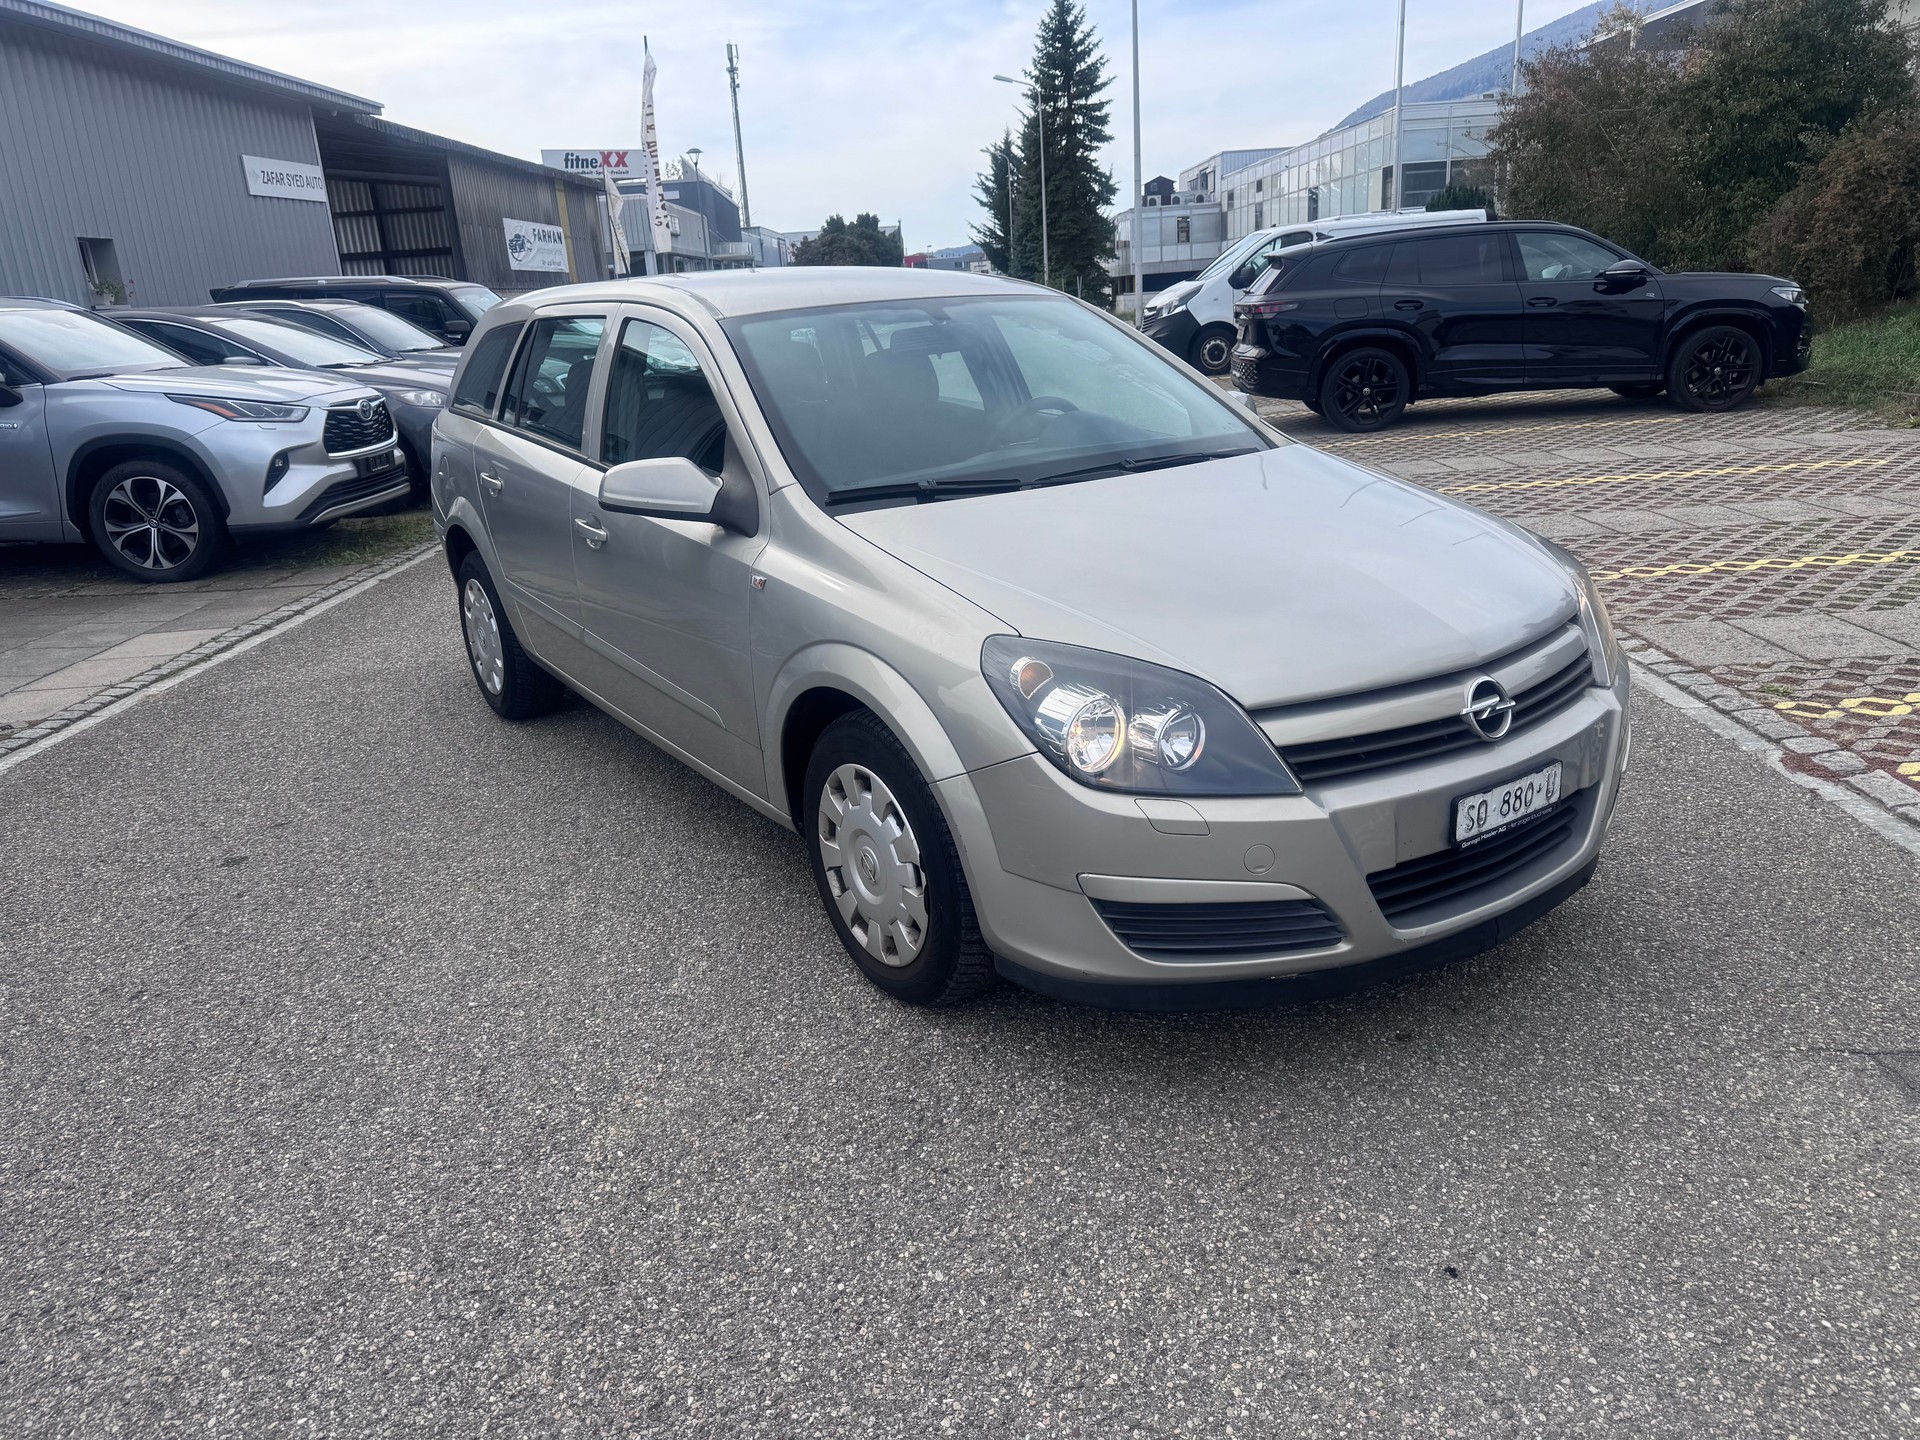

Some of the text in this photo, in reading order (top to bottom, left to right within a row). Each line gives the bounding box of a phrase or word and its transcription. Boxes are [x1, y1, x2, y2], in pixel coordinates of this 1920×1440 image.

[563, 151, 629, 169] fitneXX
[261, 170, 323, 190] ZAFAR SYED AUTO
[532, 228, 563, 245] FARHAN
